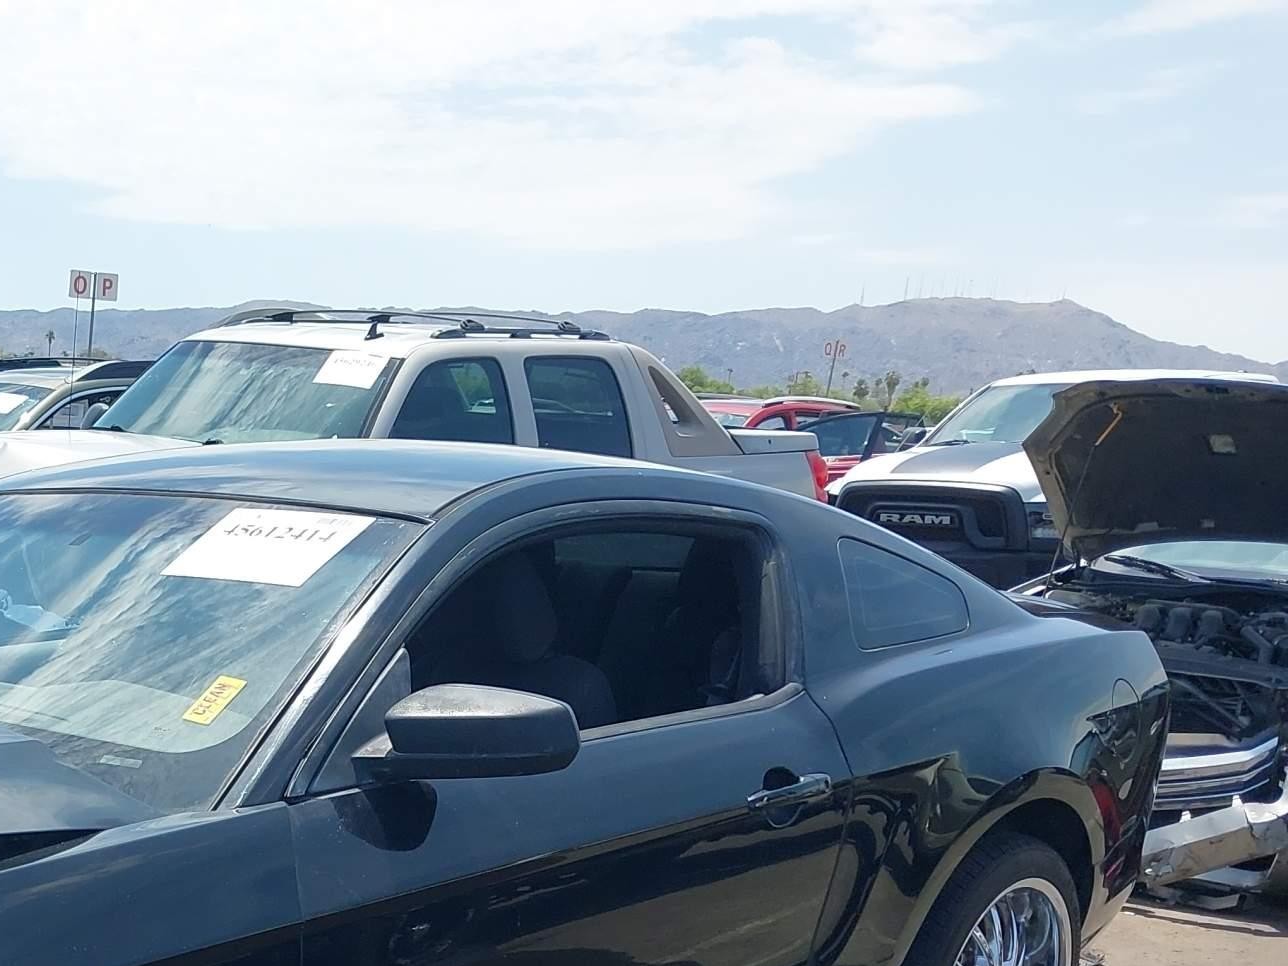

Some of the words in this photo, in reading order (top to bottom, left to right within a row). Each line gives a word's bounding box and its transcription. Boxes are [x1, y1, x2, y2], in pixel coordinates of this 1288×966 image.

[73, 275, 88, 295] O
[102, 278, 113, 297] P
[838, 344, 846, 357] R
[879, 513, 951, 525] RAM
[223, 523, 337, 542] 45612414
[192, 682, 228, 716] CLEAN
